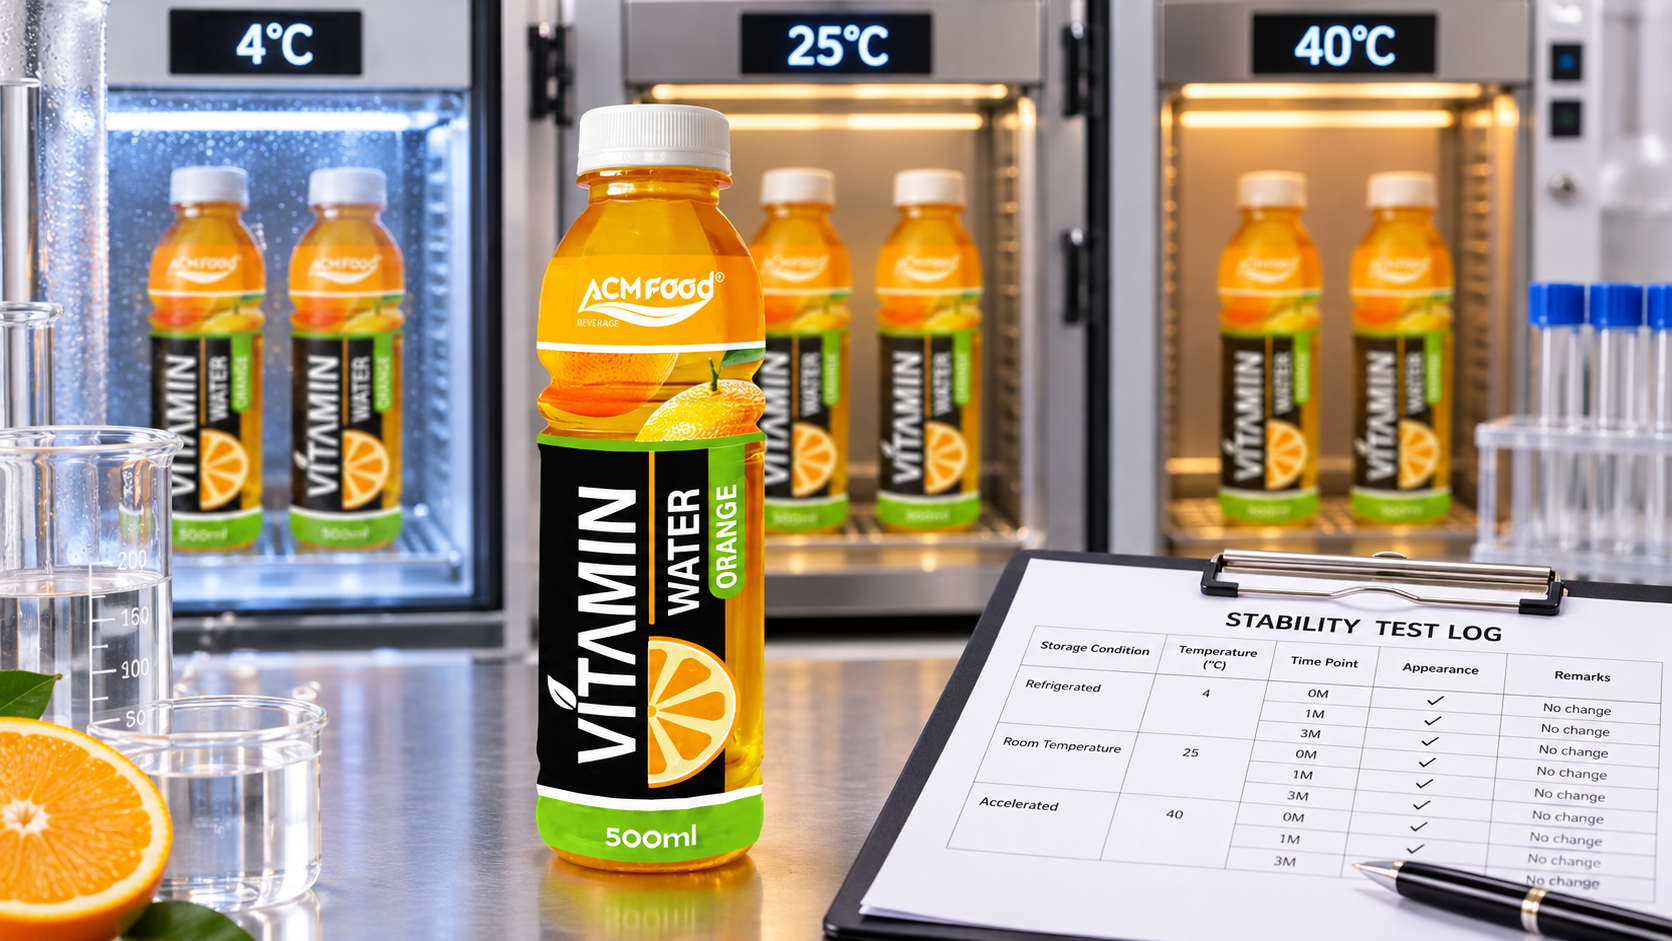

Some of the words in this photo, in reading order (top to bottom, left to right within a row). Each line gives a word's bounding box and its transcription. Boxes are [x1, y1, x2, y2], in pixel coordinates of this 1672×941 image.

[236, 22, 313, 65] 4°C
[787, 25, 889, 67] 25°C
[1294, 25, 1396, 67] 40°C
[577, 318, 620, 328] BEVERAGE
[716, 484, 738, 589] ORANGE
[667, 488, 700, 616] WATER
[117, 550, 147, 570] 200
[577, 486, 637, 765] VITAMIN
[1225, 611, 1361, 633] STABILITY
[1375, 620, 1440, 639] TEST
[1448, 624, 1503, 642] LOG
[1040, 640, 1088, 654] Storage
[1090, 644, 1150, 657] Condition
[1179, 645, 1258, 658] Temperature
[1291, 655, 1322, 667] Time
[1325, 657, 1360, 669] Point
[1402, 662, 1480, 677] Appearance
[1554, 670, 1612, 683] Remarks
[1025, 679, 1102, 694] Refrigerated
[1202, 689, 1211, 698] 4
[1308, 688, 1329, 699] 0M
[1306, 709, 1325, 719] 1M
[1543, 702, 1562, 713] No
[1564, 704, 1612, 717] change
[1300, 728, 1321, 739] 3M
[1541, 723, 1560, 734] No
[1562, 725, 1611, 739] change
[1003, 736, 1040, 749] Room
[1043, 739, 1122, 755] Temperature
[1182, 747, 1200, 758] 25
[1539, 744, 1558, 755] No
[1561, 746, 1609, 760] change
[1295, 749, 1318, 760] 0M
[1293, 770, 1313, 780] 1M
[1536, 766, 1556, 777] No
[1558, 768, 1608, 782] change
[1287, 790, 1309, 802] 3M
[1534, 787, 1553, 799] No
[1556, 789, 1606, 804] change
[978, 796, 1060, 812] Accelerated
[1165, 809, 1185, 820] 40
[1282, 812, 1305, 823] 0M
[1532, 810, 1551, 821] No
[1554, 811, 1605, 826] change
[604, 823, 698, 849] 500ml
[1280, 834, 1301, 845] 1M
[1530, 831, 1549, 843] No
[1553, 833, 1603, 849] change
[1274, 856, 1297, 868] 3M
[1527, 853, 1547, 864] No
[1551, 855, 1602, 870] change
[1548, 876, 1601, 890] change
